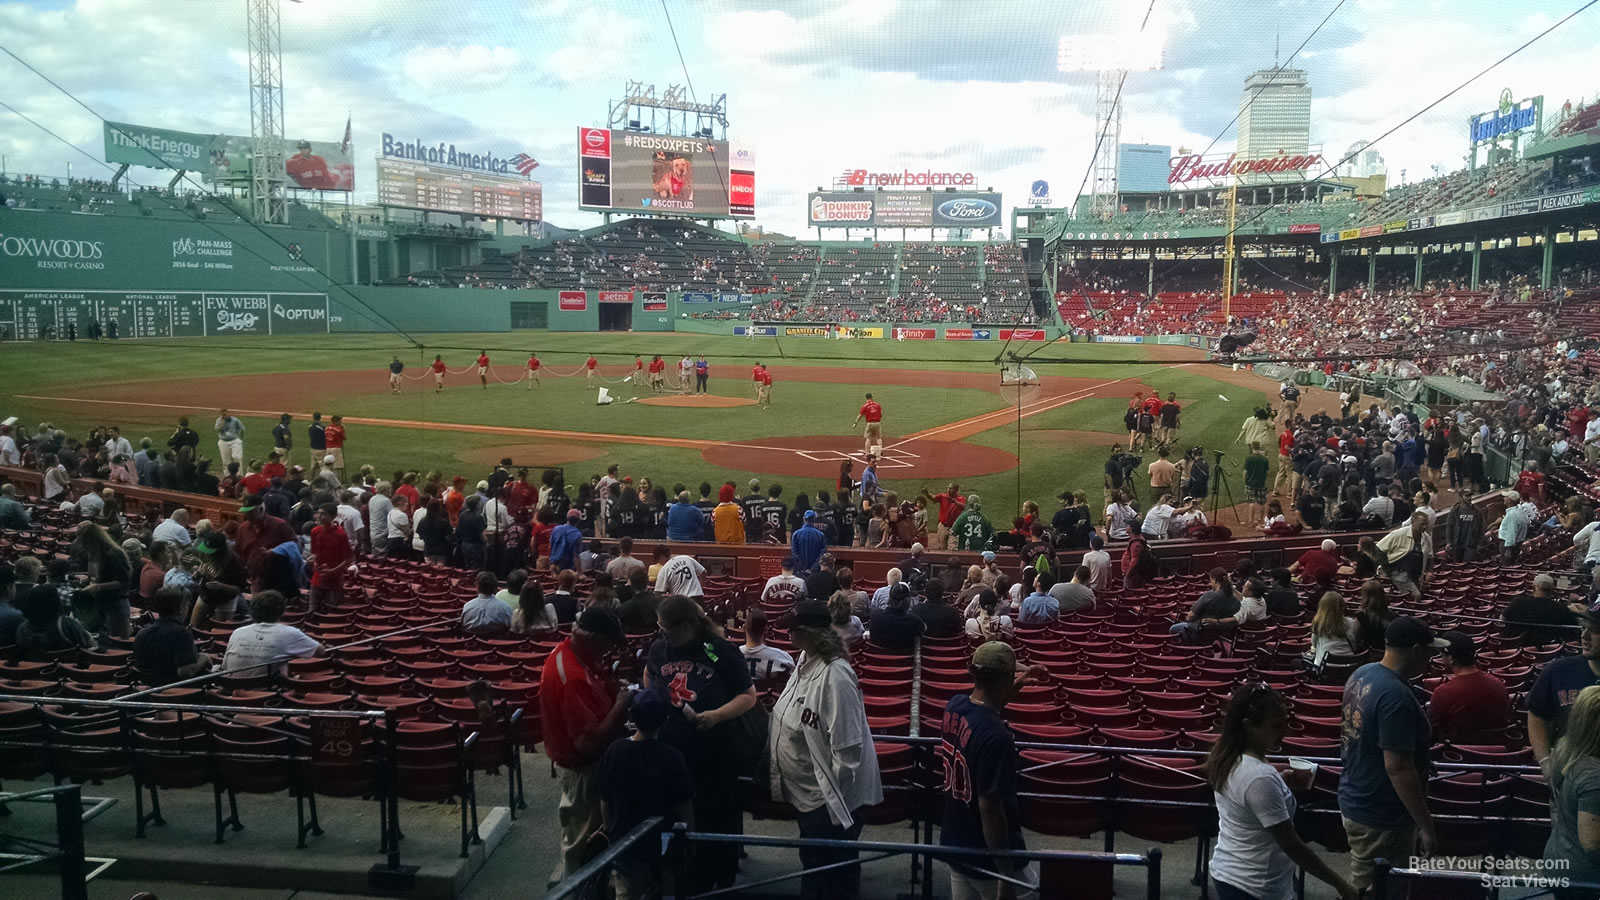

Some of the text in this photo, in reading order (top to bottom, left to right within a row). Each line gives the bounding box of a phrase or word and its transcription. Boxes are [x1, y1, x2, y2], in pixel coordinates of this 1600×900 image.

[1471, 107, 1535, 142] Cumberland
[110, 129, 200, 158] ThinkEnergy
[624, 135, 703, 153] #REDSOXPETS
[382, 132, 508, 173] Bank of America
[1168, 149, 1322, 184] Budweiser
[869, 169, 974, 185] new balance
[652, 200, 694, 209] @SCOTTLUD
[829, 203, 871, 211] DUNKIN'
[949, 201, 985, 216] Ford
[1543, 198, 1557, 210] ALEX
[1557, 195, 1572, 207] AND
[829, 211, 869, 220] DONUTS
[358, 229, 388, 238] ABIOMED
[197, 240, 232, 248] PAN-MASS
[206, 298, 267, 310] F.W. WEBB
[604, 293, 628, 301] aetna
[722, 294, 738, 302] NESN
[286, 309, 325, 320] OPTUM
[750, 506, 762, 518] 16
[766, 512, 780, 528] 16
[964, 524, 982, 538] 34
[675, 567, 692, 584] 79
[320, 720, 350, 729] FIELD
[801, 708, 819, 730] OX
[324, 728, 348, 737] BOX
[942, 712, 972, 748] BETTS
[320, 740, 353, 756] 49
[942, 738, 972, 804] 50
